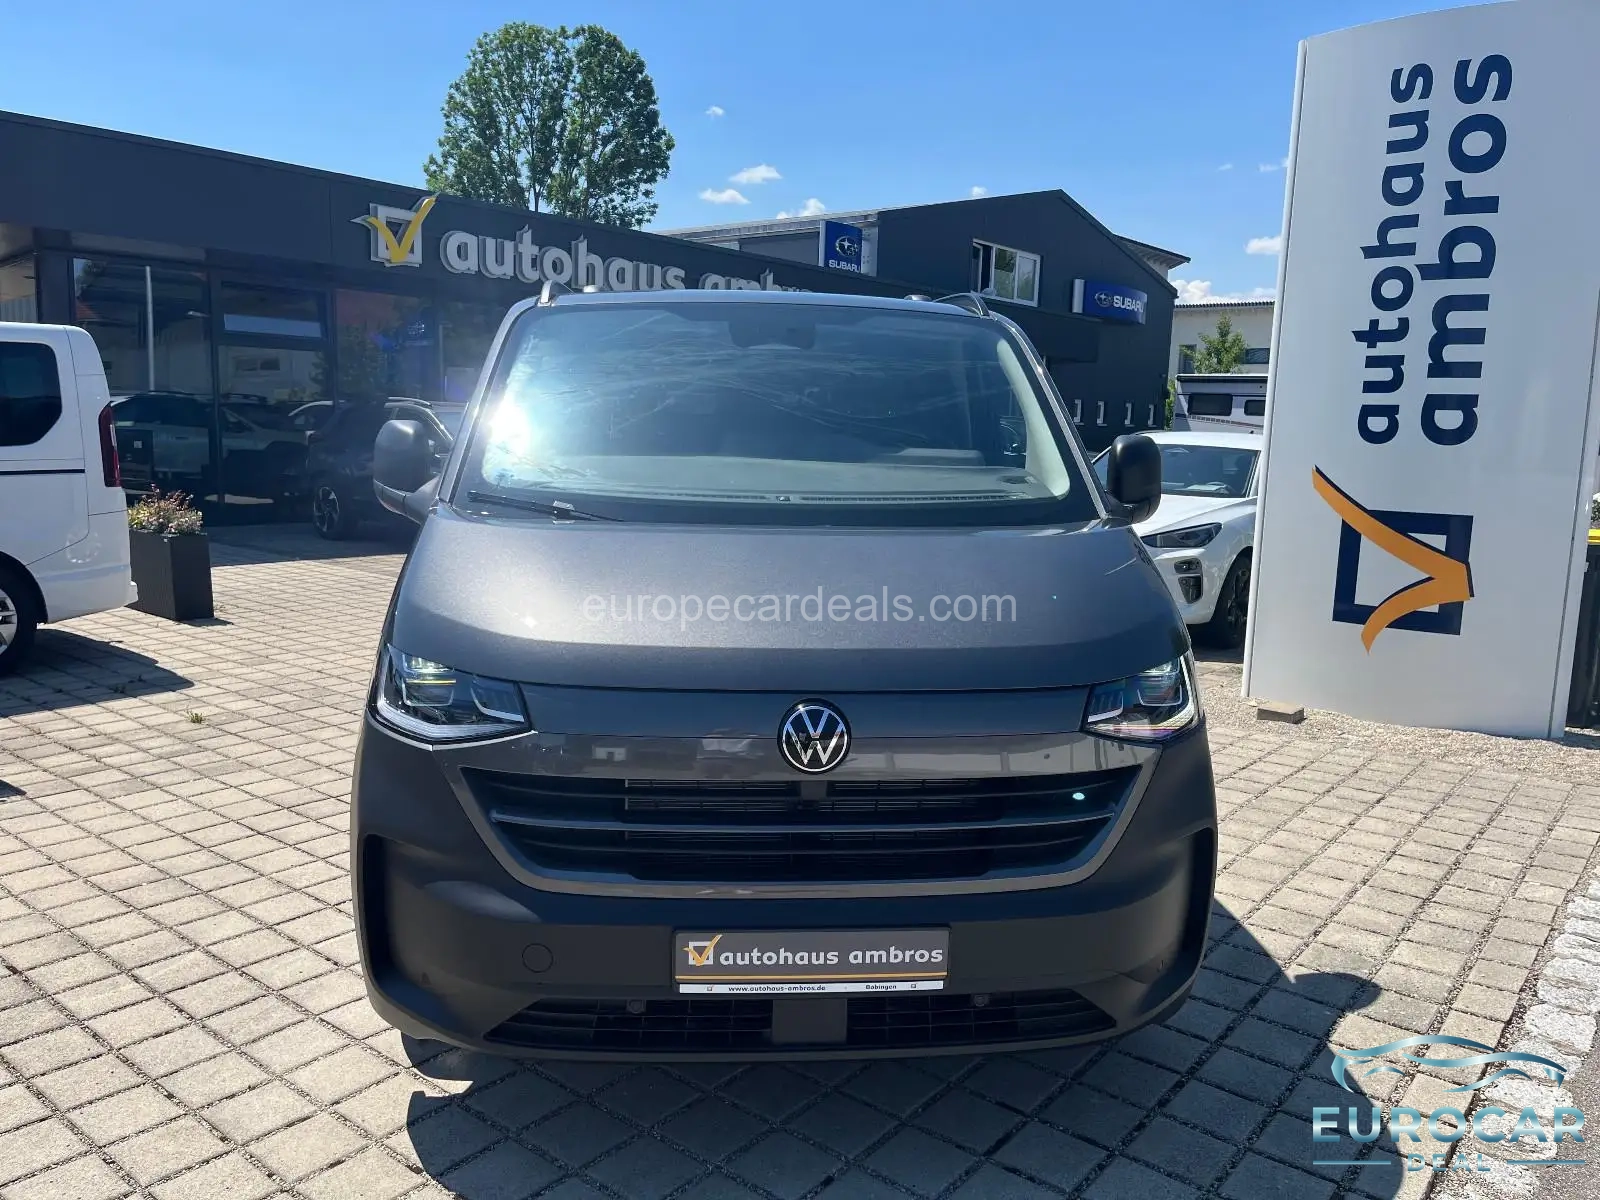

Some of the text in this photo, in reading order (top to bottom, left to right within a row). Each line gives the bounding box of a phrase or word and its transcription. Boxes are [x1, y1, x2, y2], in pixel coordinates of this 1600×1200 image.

[440, 224, 686, 291] autohaus
[1352, 62, 1434, 445] autohaus
[1414, 53, 1513, 446] ambros
[828, 259, 861, 273] SUBARU
[1113, 295, 1144, 313] SUBARU
[719, 945, 943, 966] autohaus ambros
[728, 984, 826, 993] www.autohaus-ambros.de
